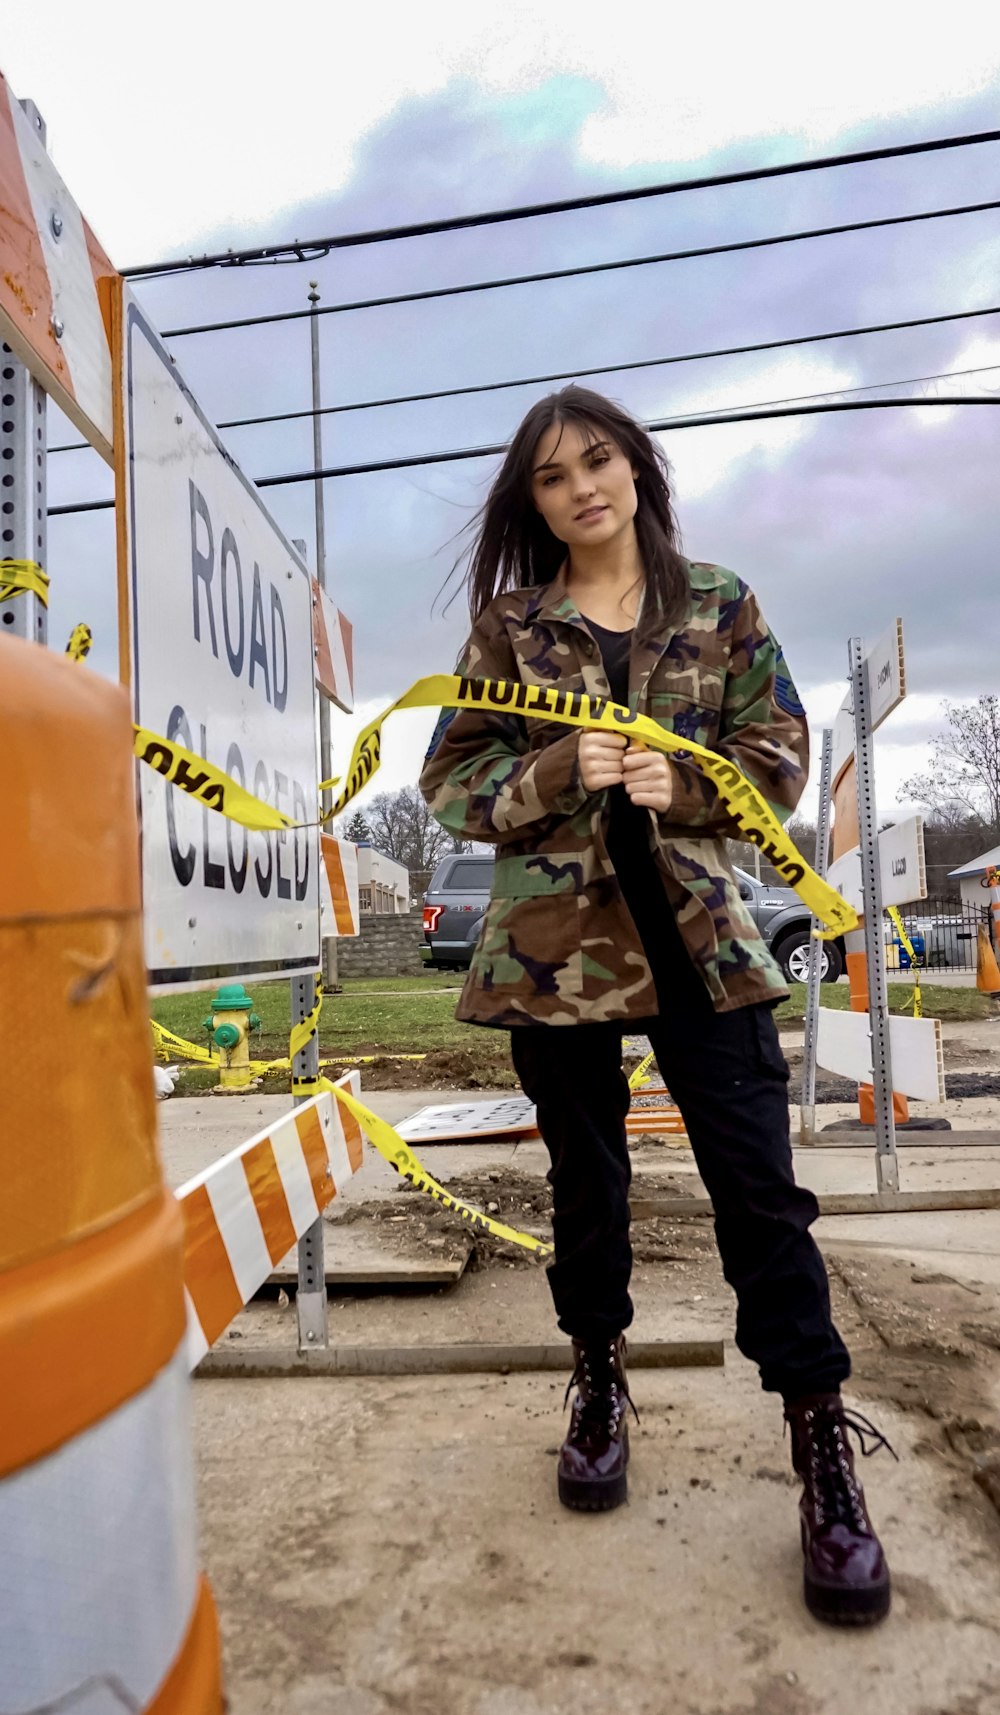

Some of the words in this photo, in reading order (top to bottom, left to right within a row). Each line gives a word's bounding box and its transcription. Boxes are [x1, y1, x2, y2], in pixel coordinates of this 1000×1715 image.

[189, 477, 288, 714] ROAD
[457, 677, 638, 725] CAUTION
[166, 704, 310, 902] CLOSED
[389, 1160, 491, 1235] AUTION
